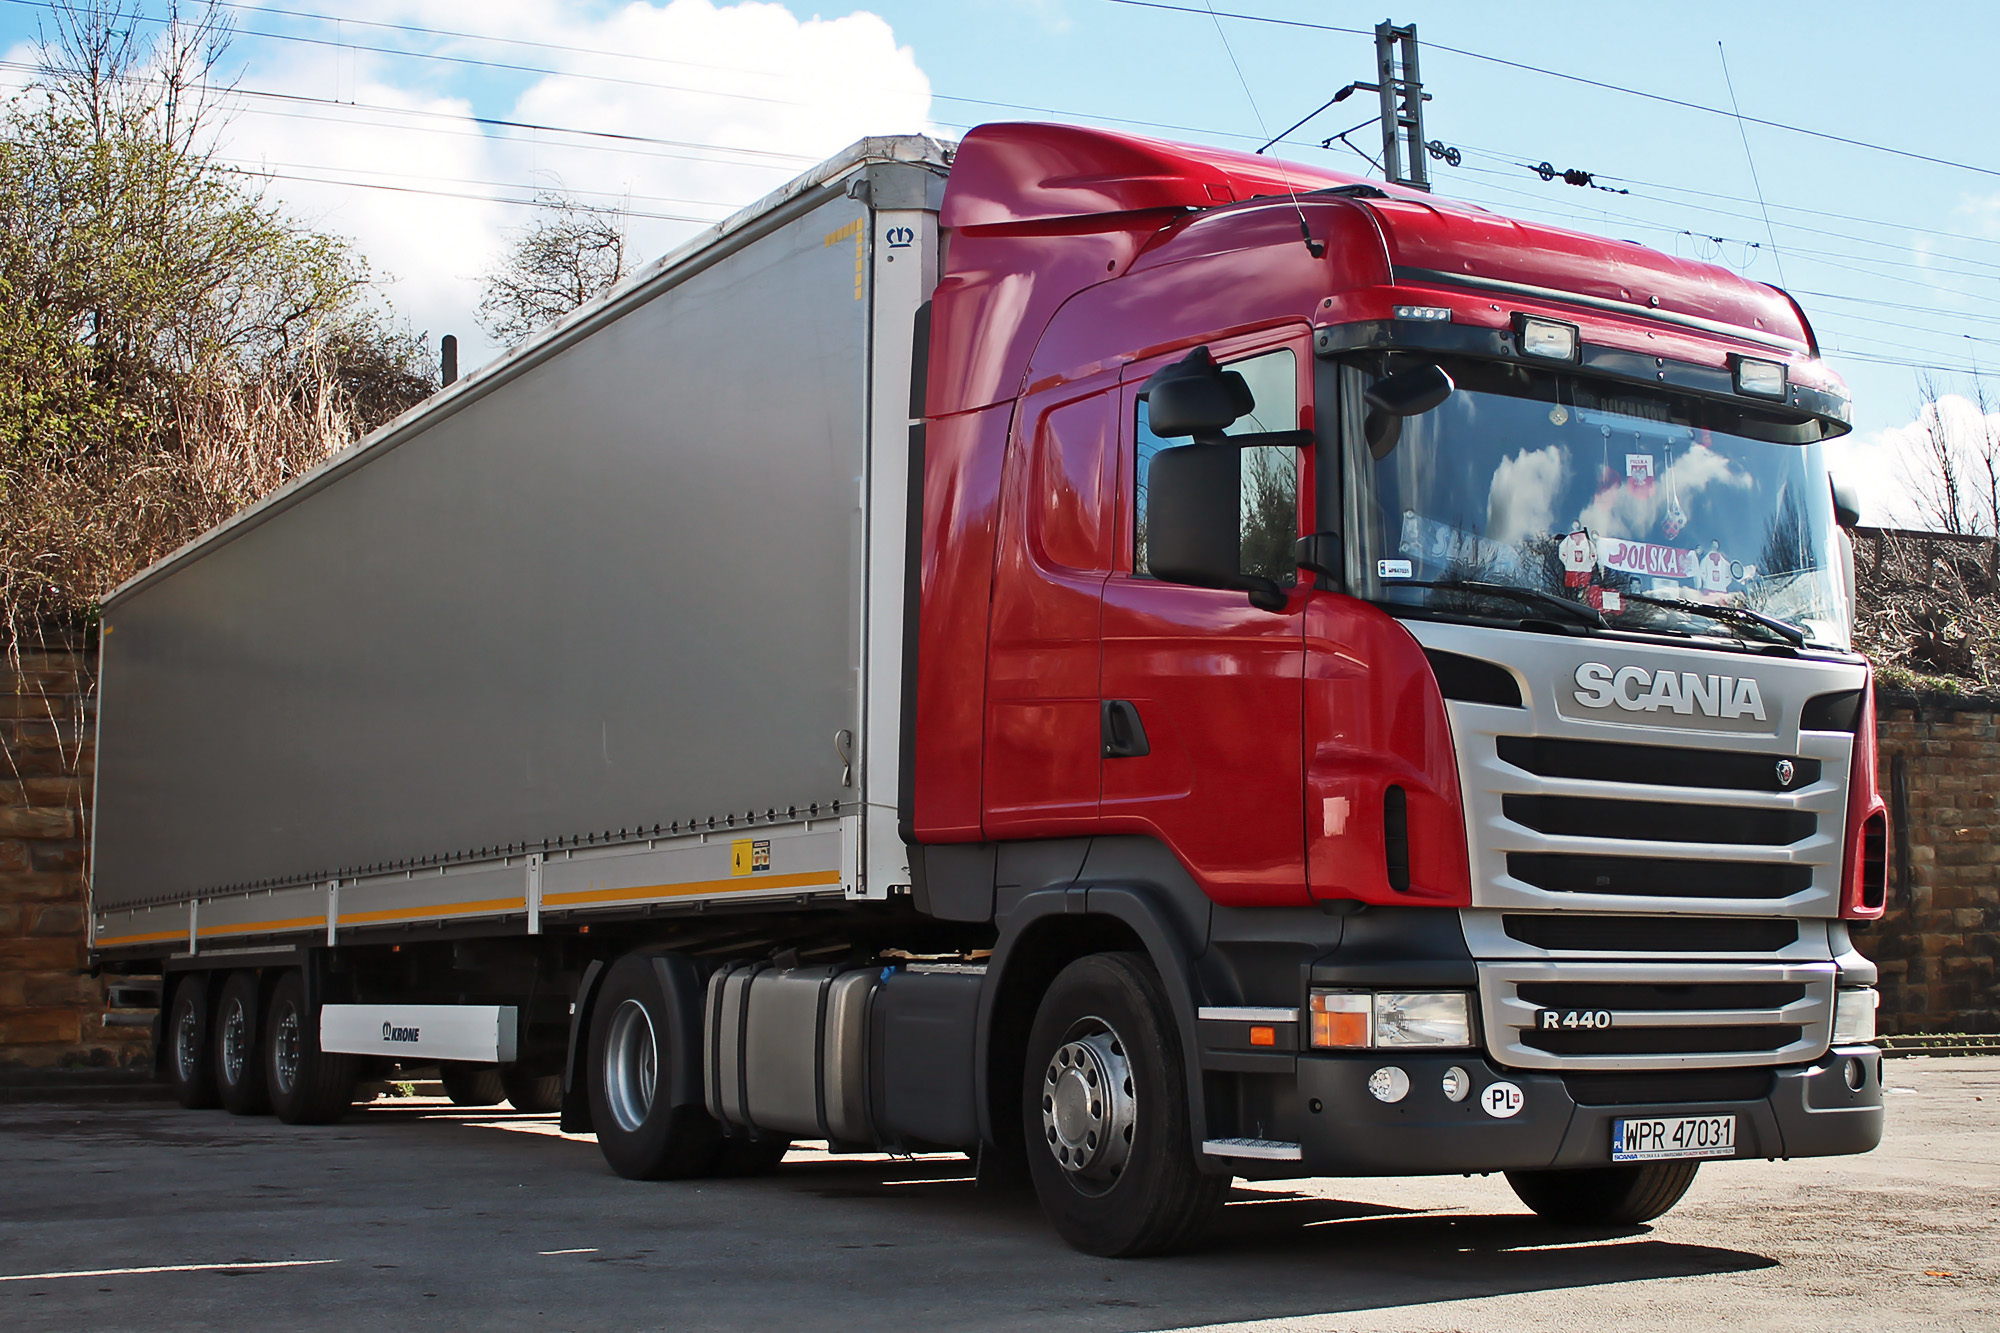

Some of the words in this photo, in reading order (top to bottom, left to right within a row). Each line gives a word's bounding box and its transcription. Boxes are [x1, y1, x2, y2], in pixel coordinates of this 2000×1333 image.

[1608, 543, 1678, 574] POLSKA
[1573, 662, 1766, 721] SCANIA
[736, 852, 740, 867] 4
[1543, 1011, 1559, 1029] R
[1562, 1011, 1610, 1029] 440
[391, 1027, 419, 1042] KRONE
[1492, 1089, 1515, 1109] PL
[1626, 1122, 1666, 1151] WPR
[1672, 1118, 1731, 1148] 47031
[1614, 1141, 1622, 1149] PL
